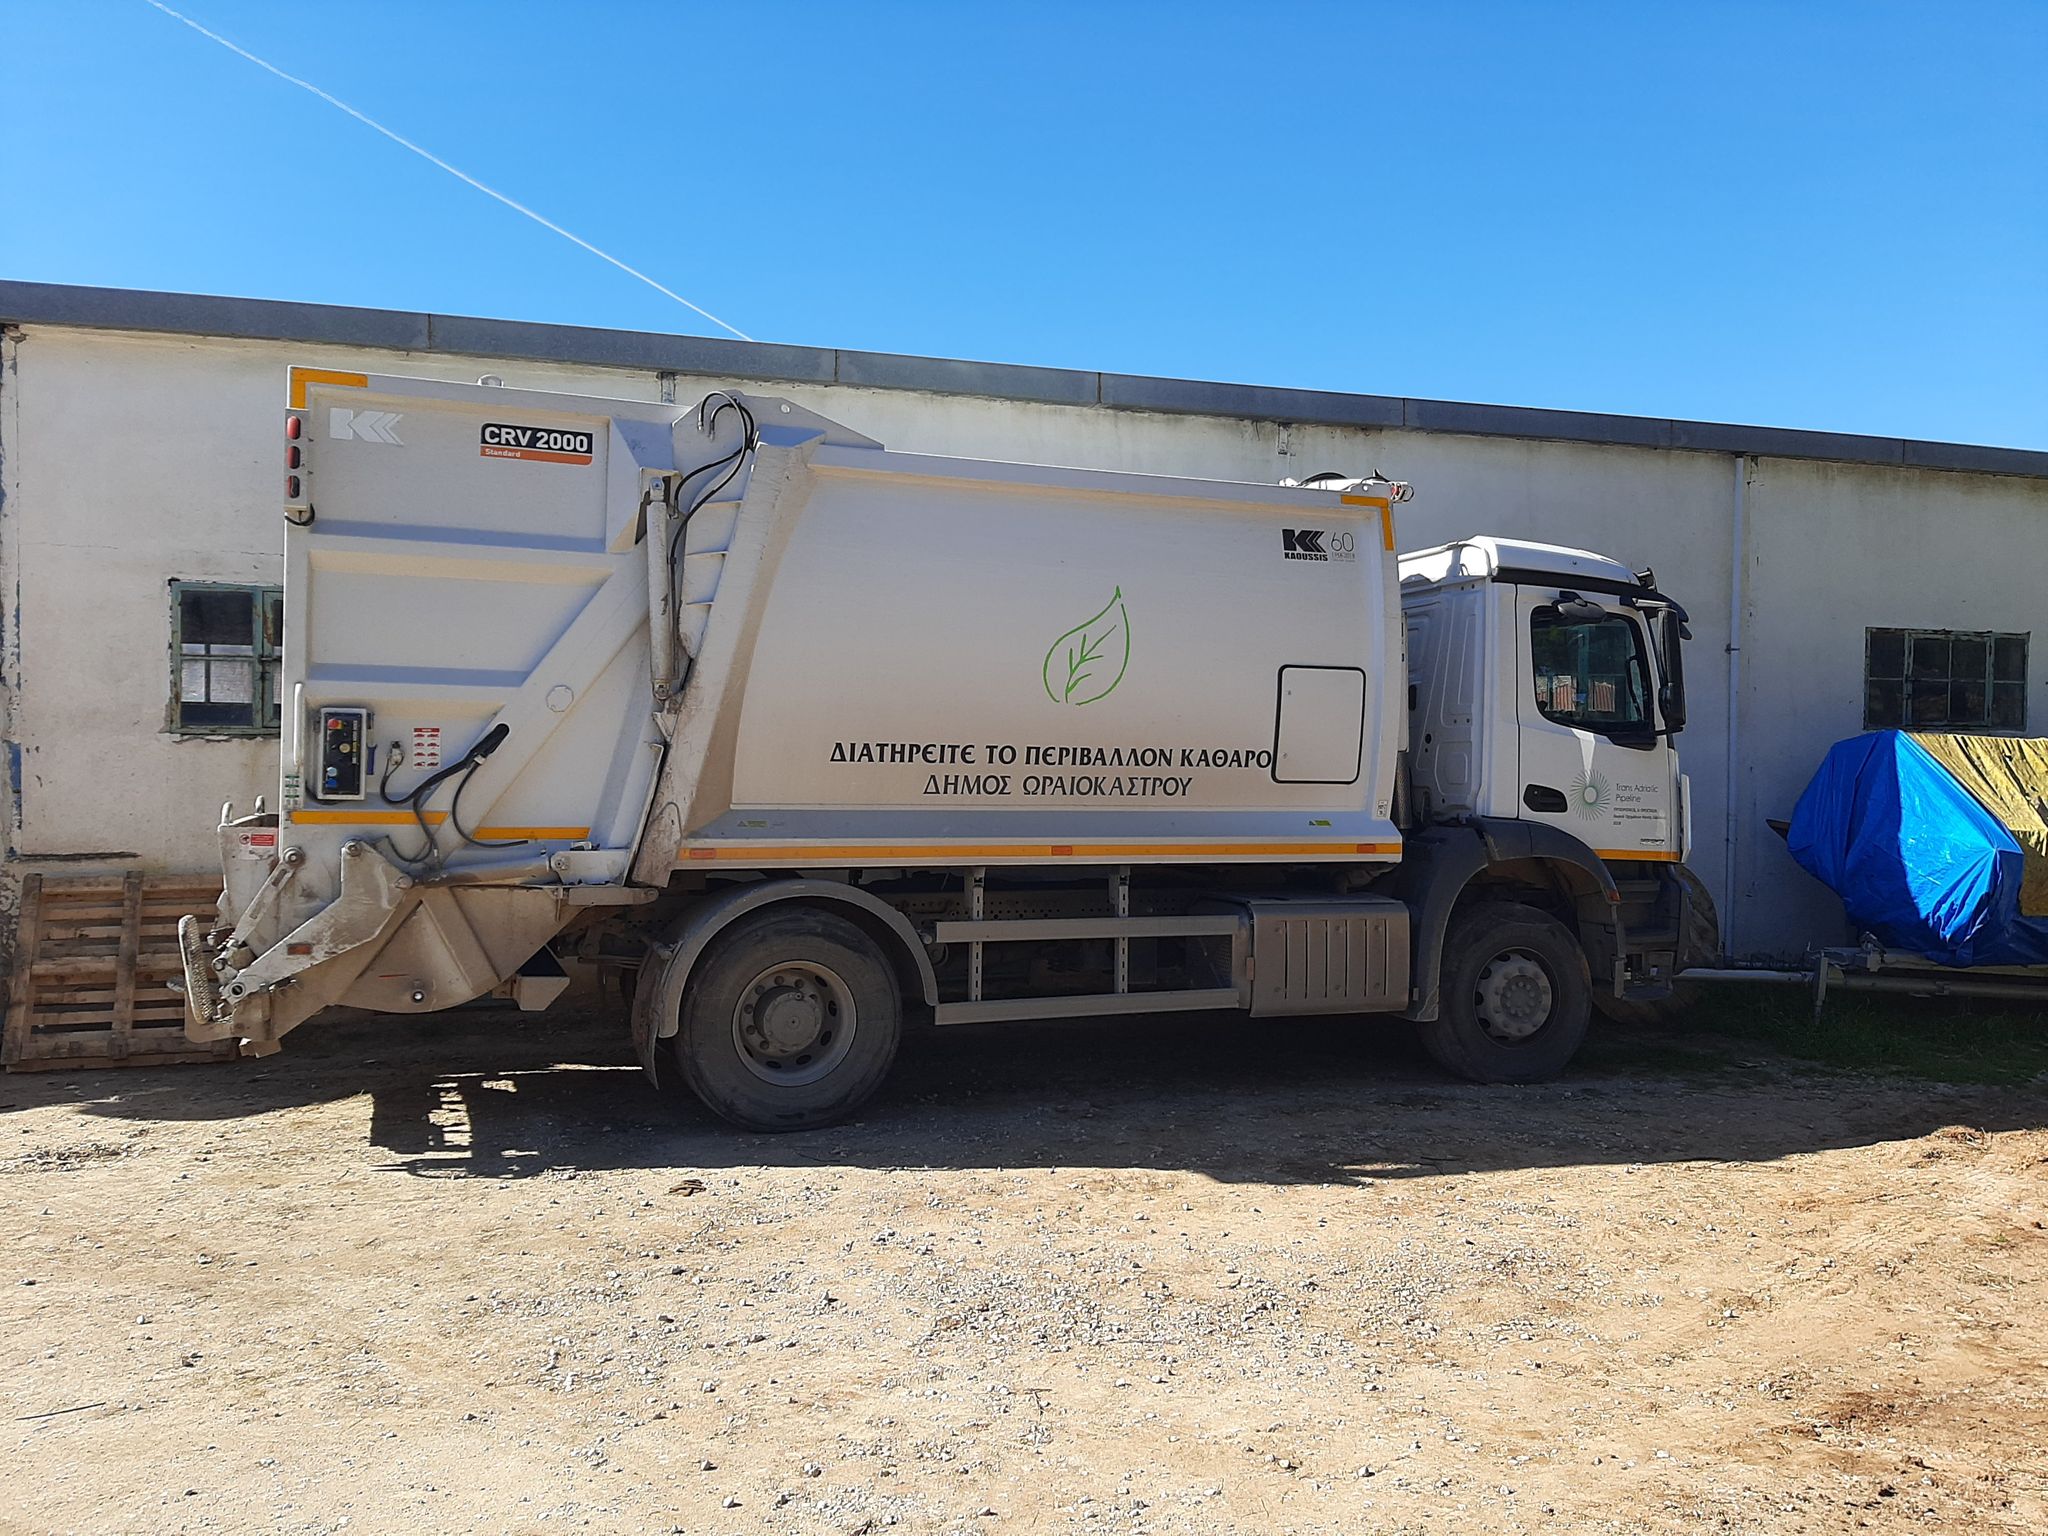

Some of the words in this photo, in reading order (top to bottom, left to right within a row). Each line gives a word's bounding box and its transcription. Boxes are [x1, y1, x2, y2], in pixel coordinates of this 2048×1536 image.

[484, 426, 532, 446] CRV
[535, 431, 588, 452] 2000
[485, 448, 521, 458] Standard
[1331, 532, 1354, 552] 60
[1284, 552, 1328, 561] KAOUSSIS
[829, 742, 976, 765] ΔΙΑΤΗΡΕΙΤΕ
[985, 745, 1017, 765] ΤΟ
[1024, 746, 1173, 767] ΠΕΡΙΒΑΛΛΟΝ
[1179, 748, 1272, 769] ΚΑΘΑΡΟ
[923, 774, 1012, 795] ΔΗΜΟΣ
[1022, 775, 1193, 797] ΩΡΑΙΟΚΑΣΤΡΟΥ
